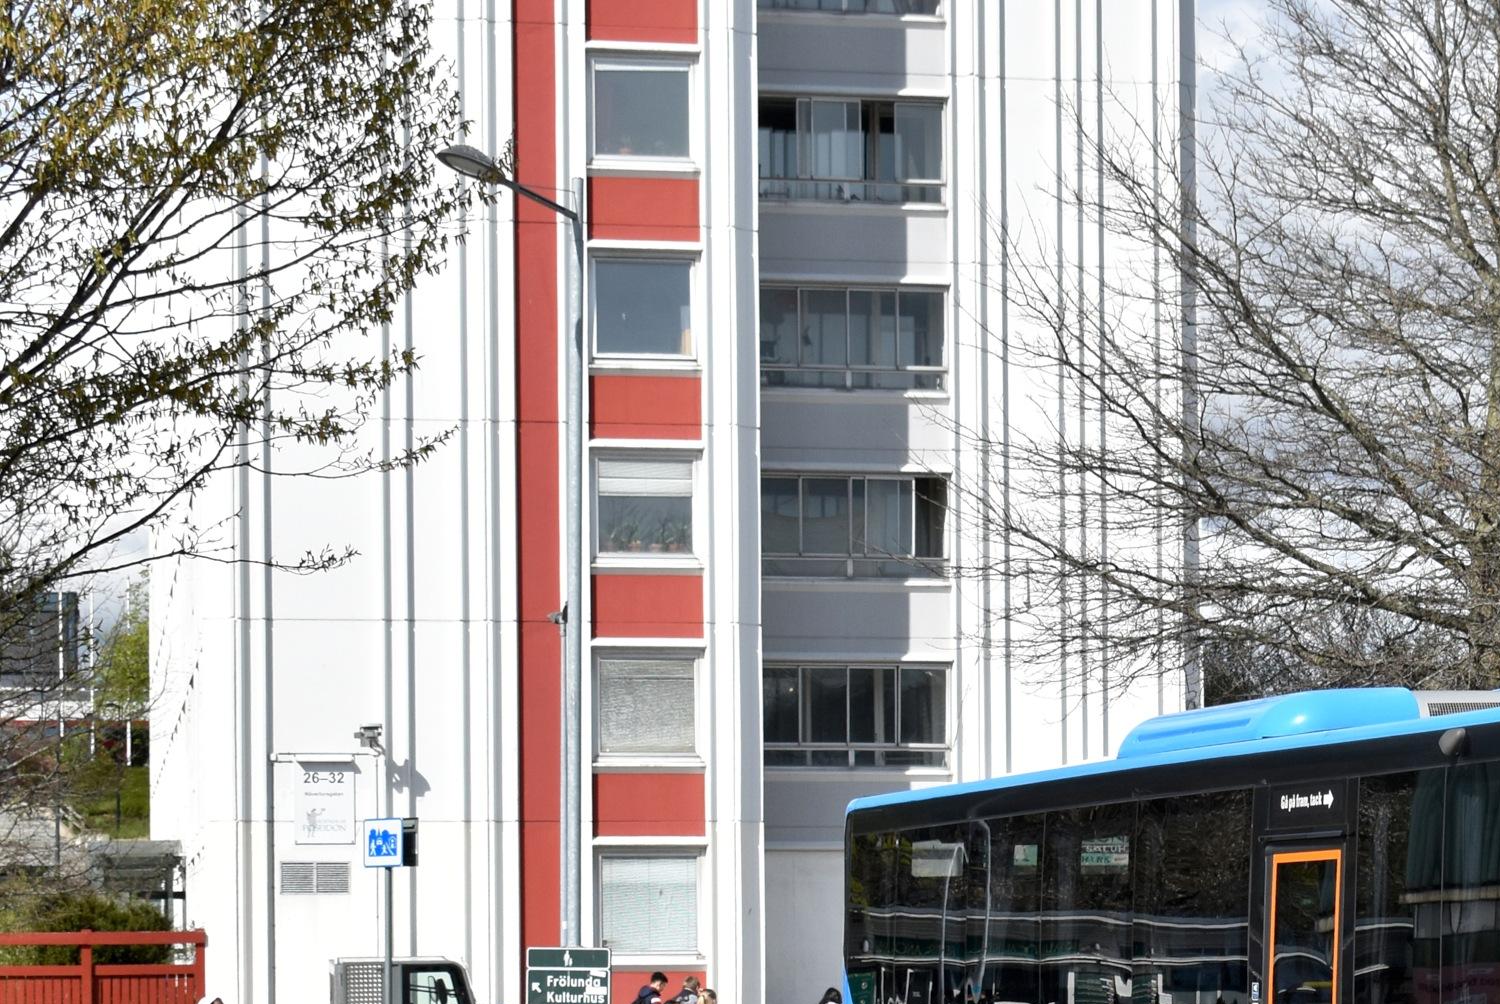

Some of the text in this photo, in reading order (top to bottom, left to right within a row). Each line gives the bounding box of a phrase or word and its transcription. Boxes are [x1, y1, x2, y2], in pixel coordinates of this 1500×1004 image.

[1310, 791, 1323, 806] tack
[546, 975, 601, 988] Frölunda
[546, 991, 605, 1004] Kulturhus
